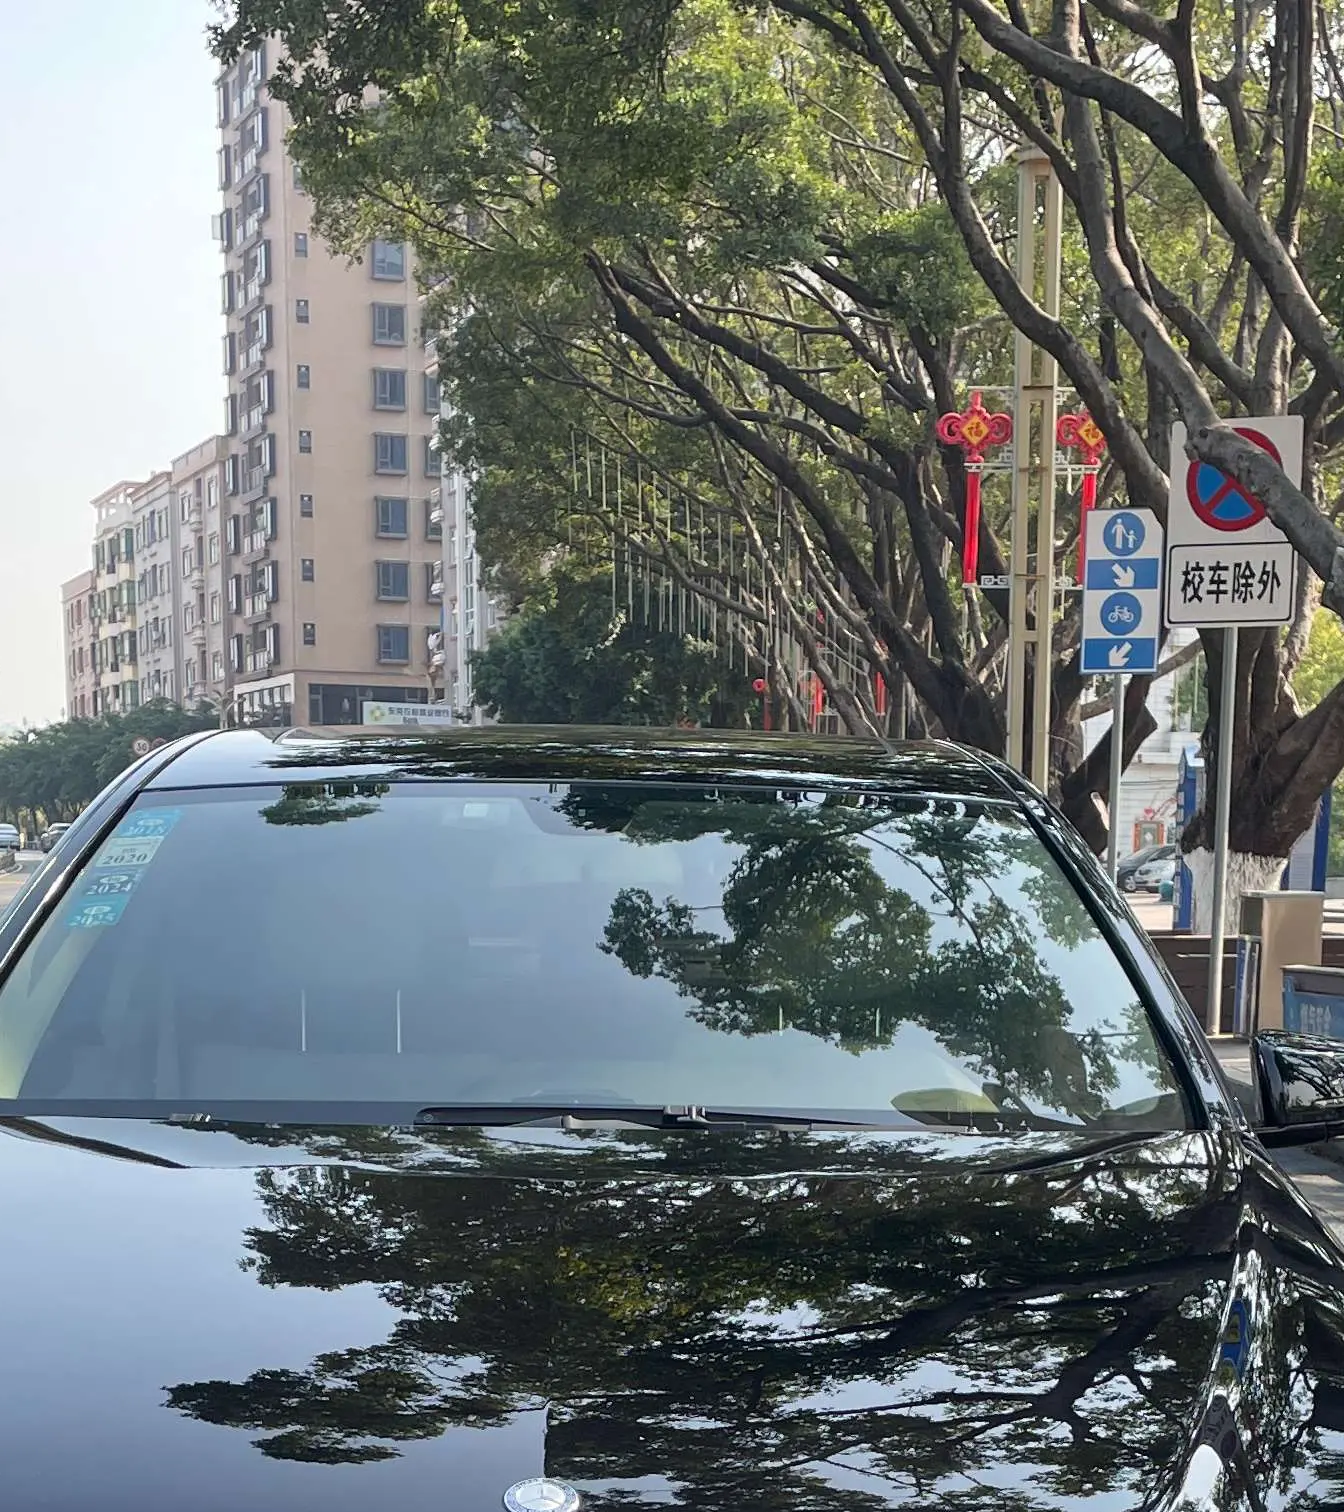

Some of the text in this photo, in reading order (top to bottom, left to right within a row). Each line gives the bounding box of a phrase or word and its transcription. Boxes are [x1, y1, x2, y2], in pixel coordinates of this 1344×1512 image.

[967, 421, 984, 438] 福
[1084, 423, 1100, 439] 福
[1180, 560, 1281, 604] 校车除外
[102, 853, 148, 865] 2020
[86, 881, 133, 896] 2024
